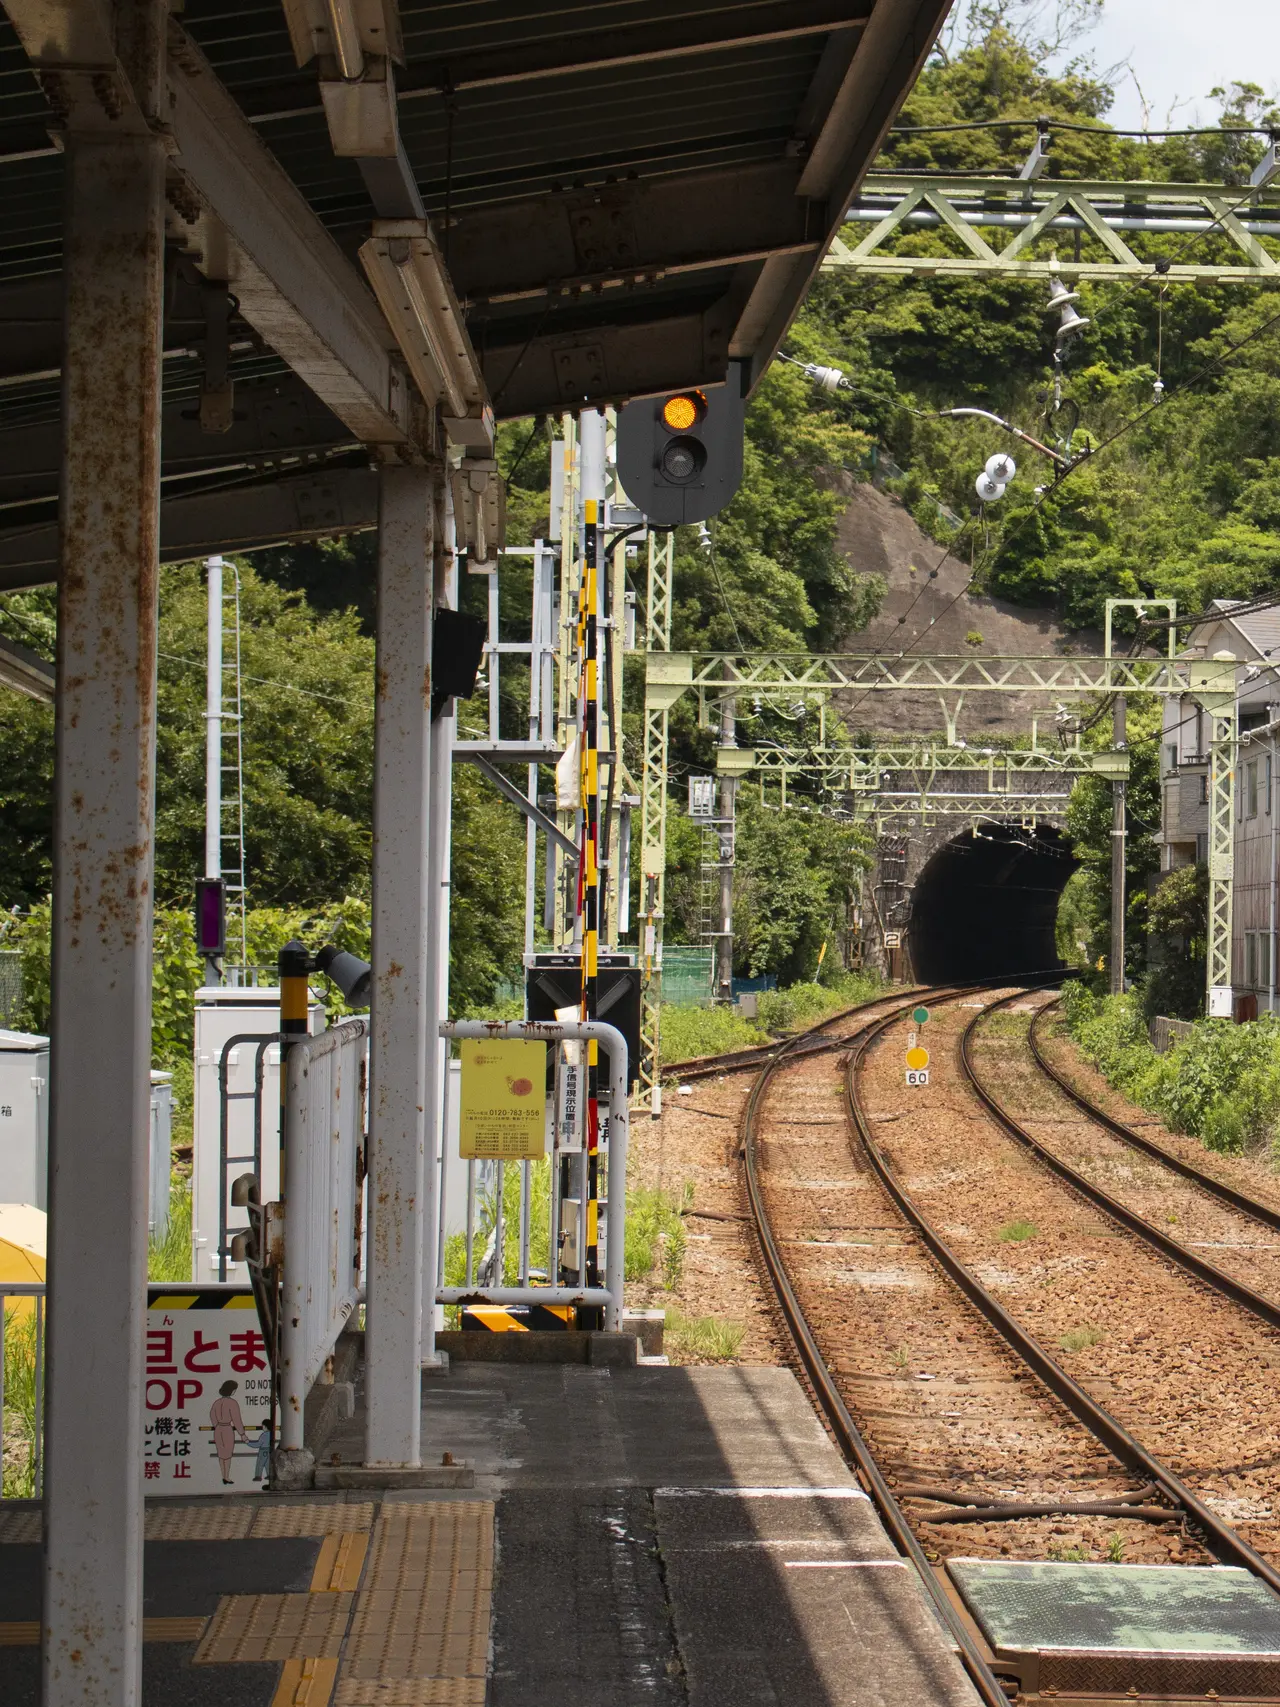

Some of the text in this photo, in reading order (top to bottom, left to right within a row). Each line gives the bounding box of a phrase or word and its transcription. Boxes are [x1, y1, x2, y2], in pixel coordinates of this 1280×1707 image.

[886, 933, 898, 946] 2
[908, 1073, 927, 1084] 60
[566, 1065, 577, 1121] 手信号現示位置
[245, 1380, 256, 1390] DO
[245, 1396, 258, 1405] THE
